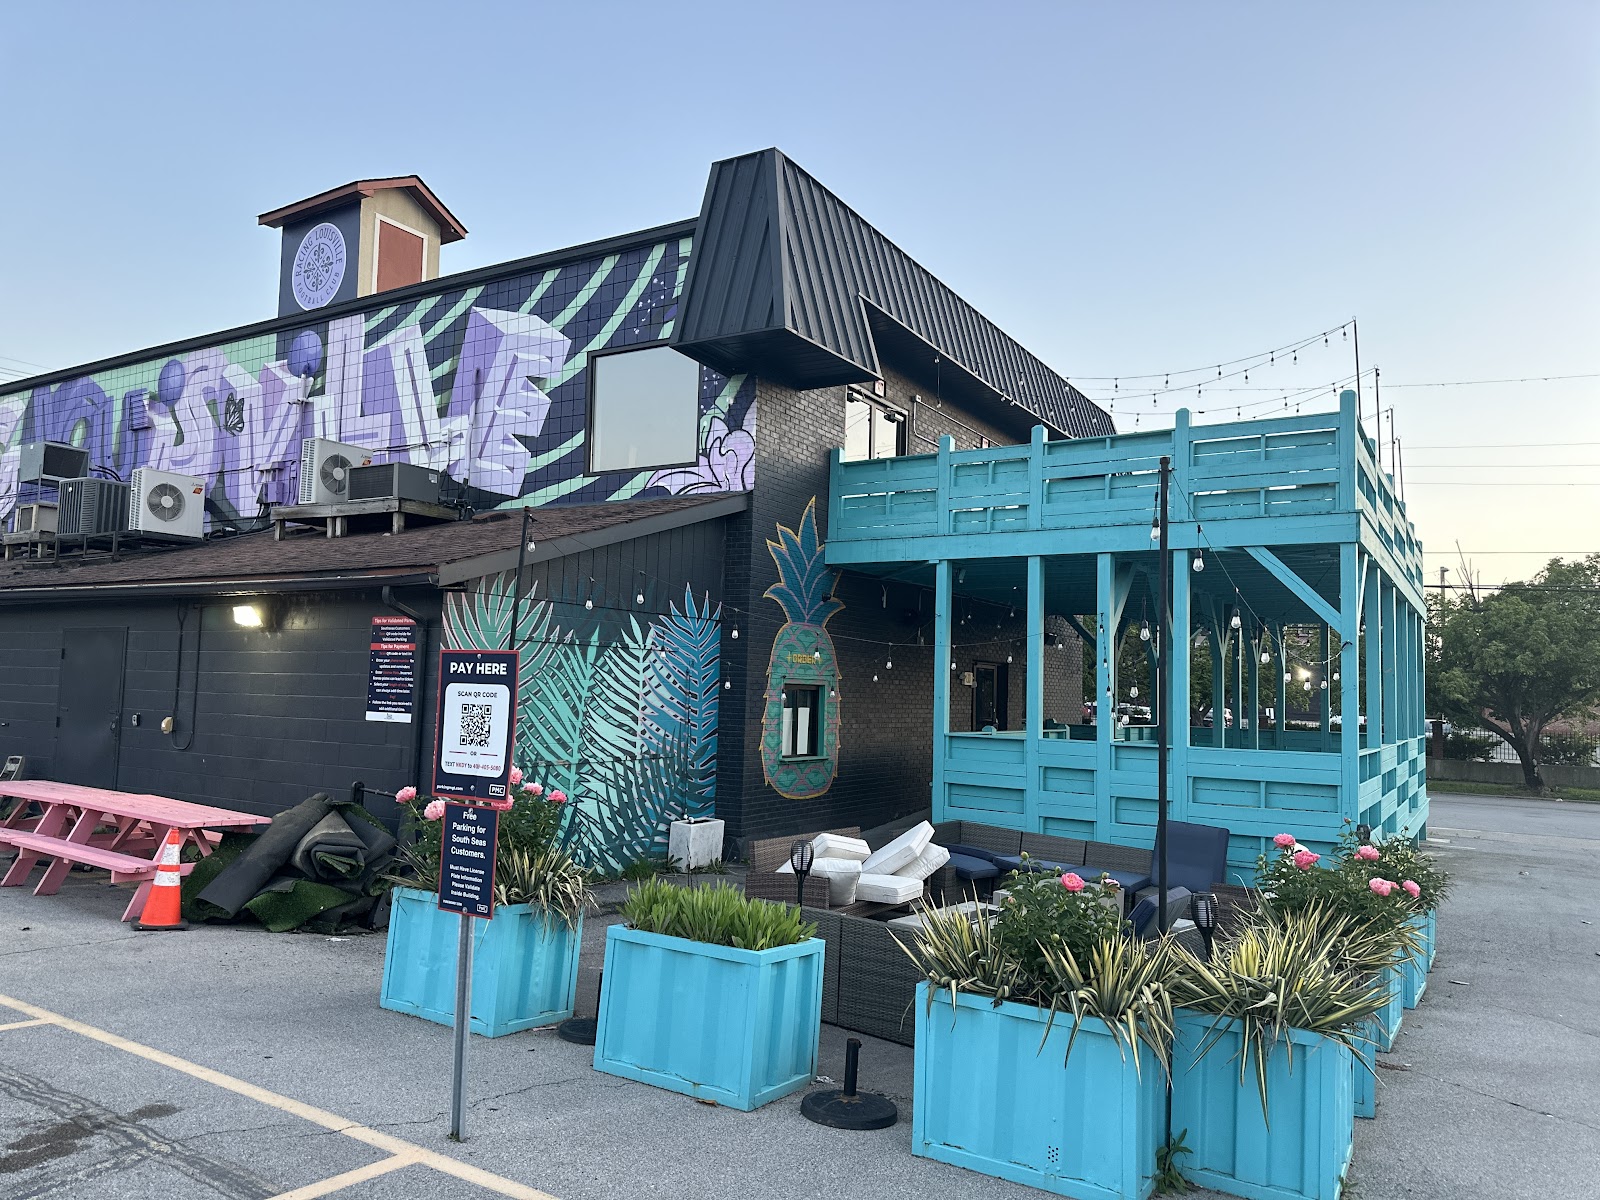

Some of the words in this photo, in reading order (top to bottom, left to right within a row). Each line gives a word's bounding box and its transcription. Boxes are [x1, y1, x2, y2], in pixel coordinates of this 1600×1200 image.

[296, 236, 314, 276] RACING
[315, 228, 342, 264] LOUISVILLE
[296, 282, 324, 304] FOOTBALL
[325, 272, 340, 295] CLUB
[450, 662, 474, 674] PAY
[476, 662, 507, 675] HERE
[463, 811, 477, 820] Free
[452, 822, 475, 834] Parking
[477, 826, 486, 834] for
[452, 834, 470, 844] South
[471, 837, 486, 846] Seas
[461, 875, 482, 883] Information
[463, 892, 480, 900] Building.
